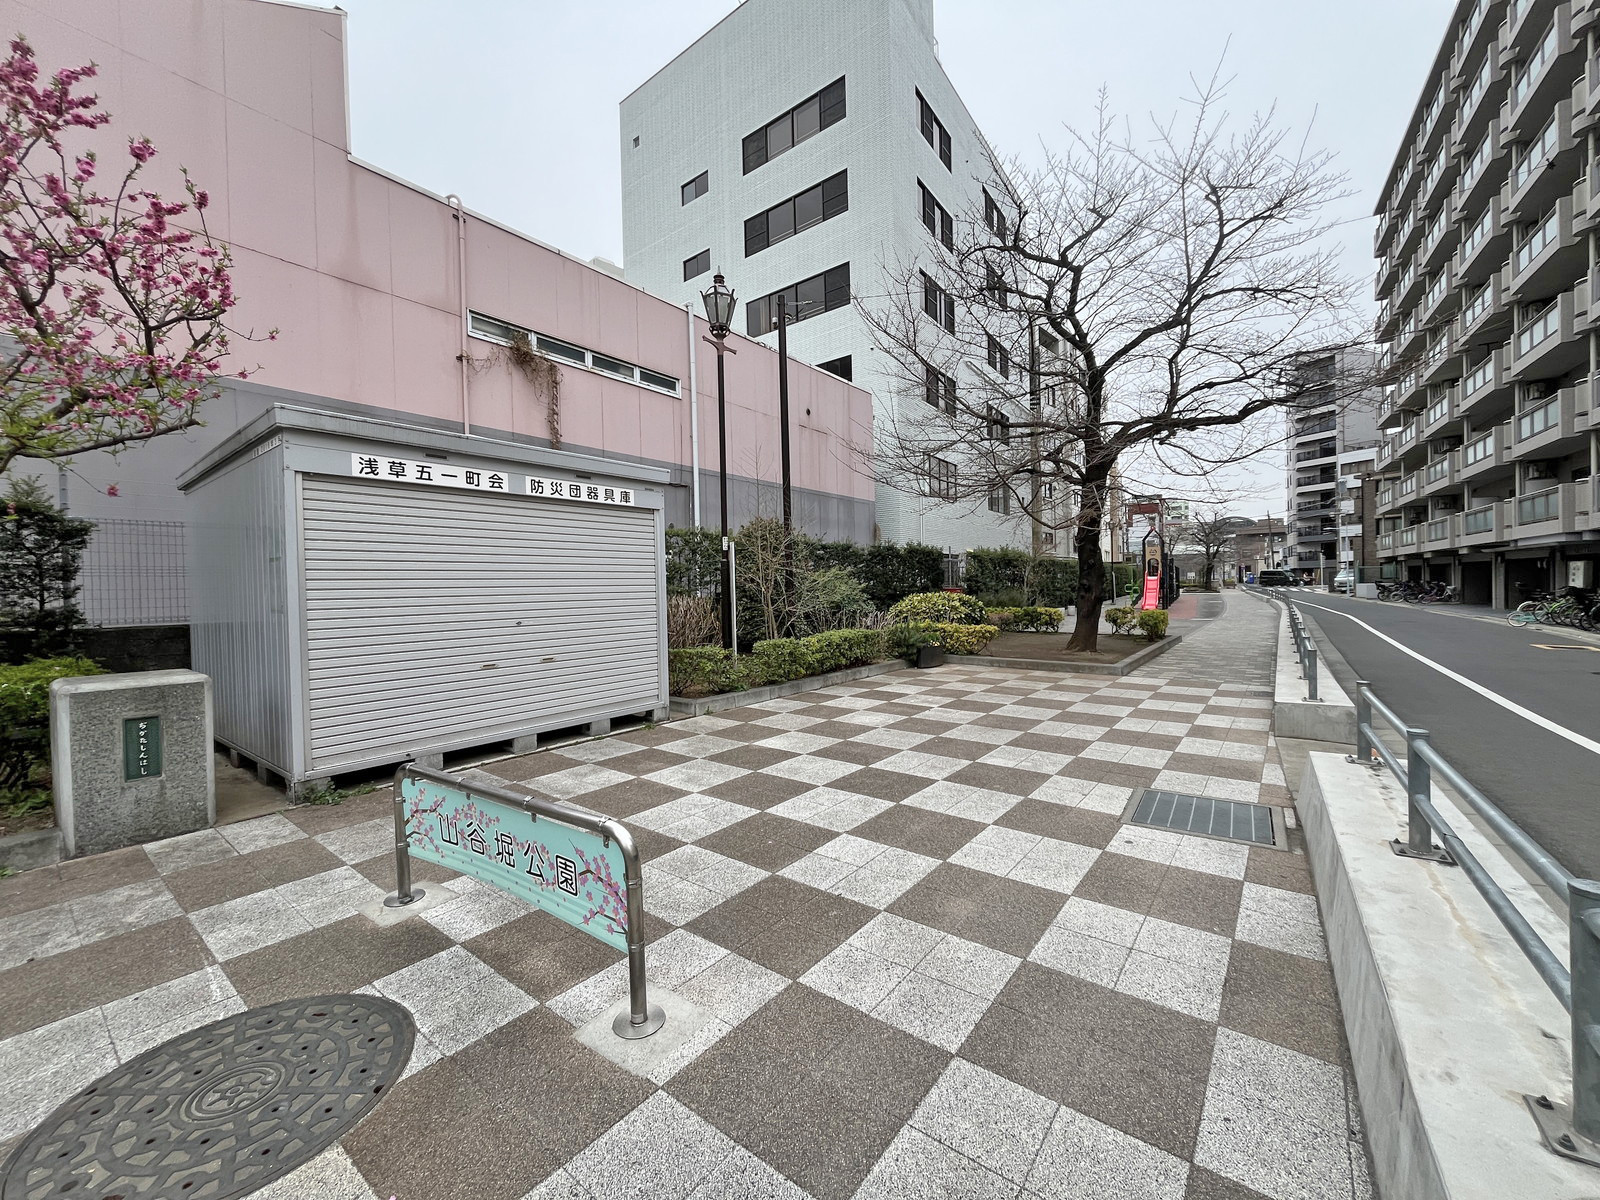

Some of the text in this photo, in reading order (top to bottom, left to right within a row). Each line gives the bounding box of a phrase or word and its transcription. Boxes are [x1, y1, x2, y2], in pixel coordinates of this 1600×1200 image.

[358, 456, 632, 504] 浅草五一町会 防災団器具庫
[438, 813, 579, 897] 山谷堀公園
